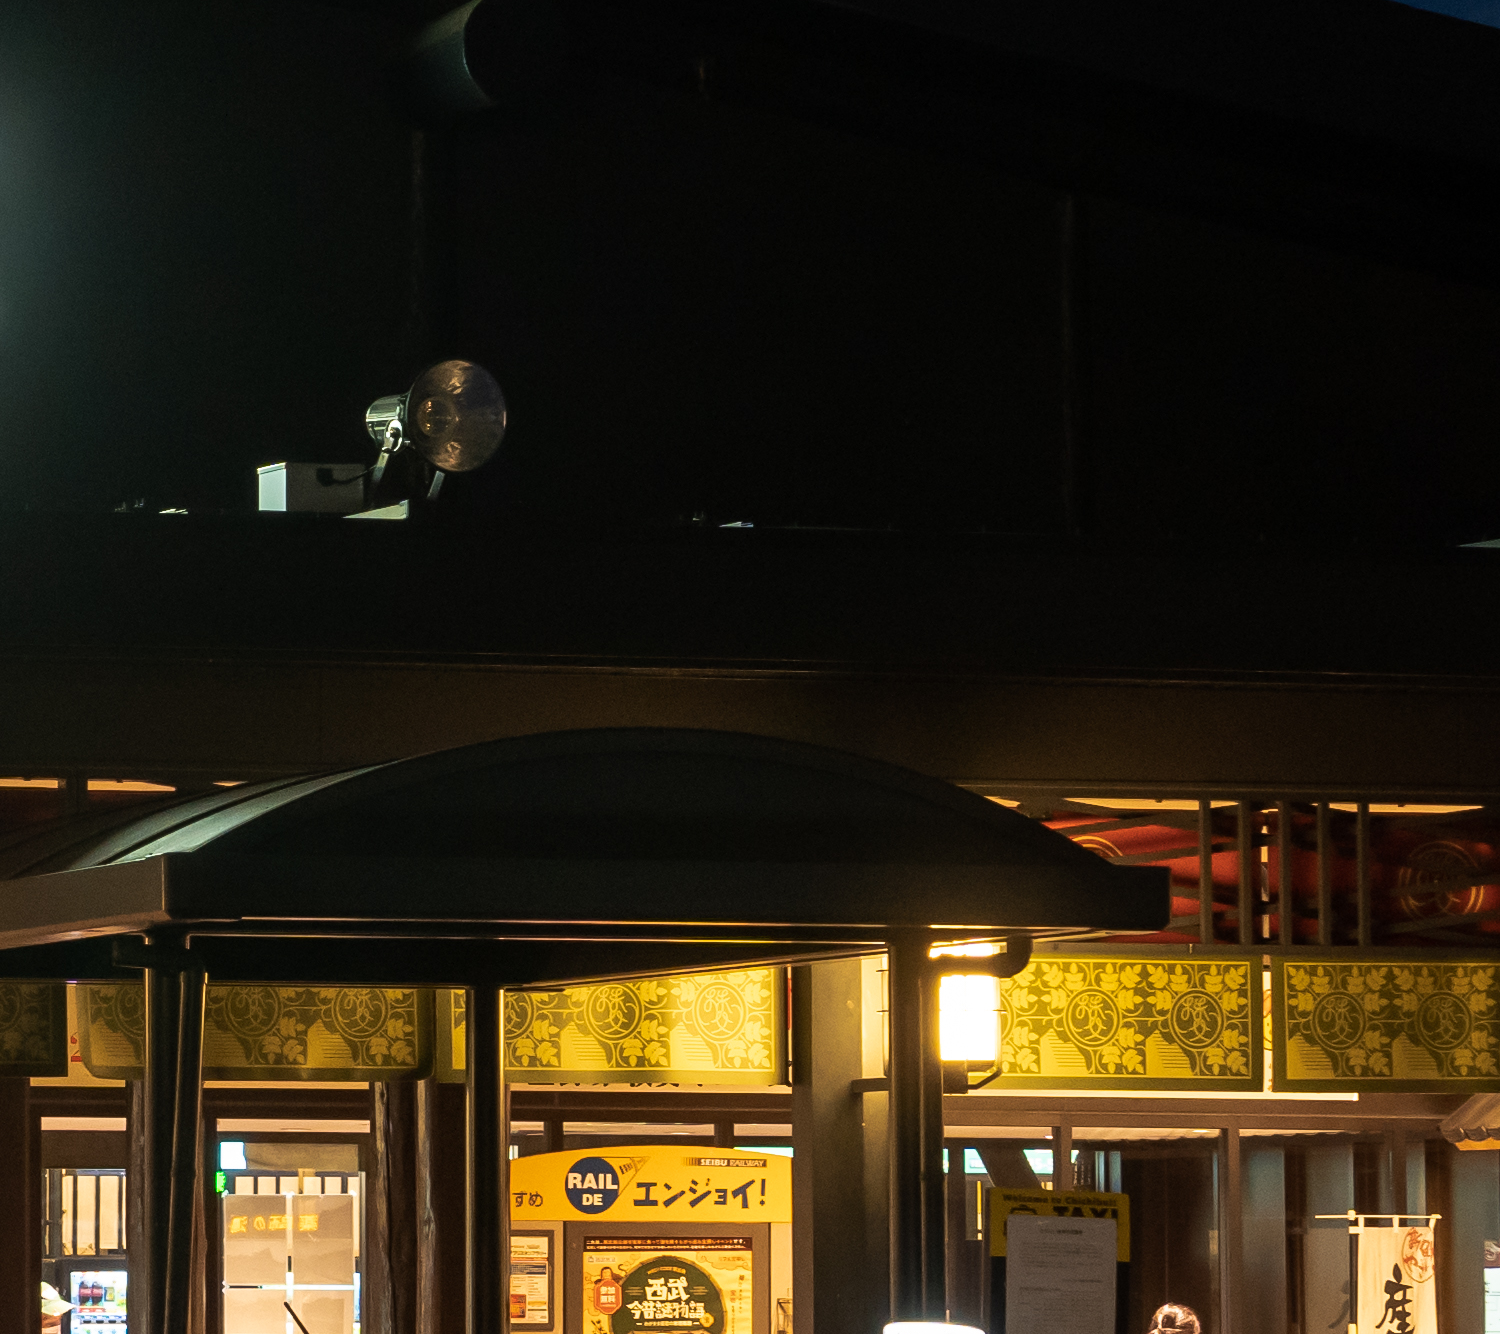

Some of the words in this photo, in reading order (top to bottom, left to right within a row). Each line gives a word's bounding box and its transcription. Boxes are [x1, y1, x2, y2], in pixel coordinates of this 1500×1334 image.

[700, 1158, 728, 1166] SEIBU
[729, 1159, 765, 1167] RAILWAY
[567, 1172, 618, 1190] RAIL
[582, 1194, 604, 1206] DE
[633, 1178, 766, 1209] エンジョイ!
[644, 1276, 691, 1302] 西武
